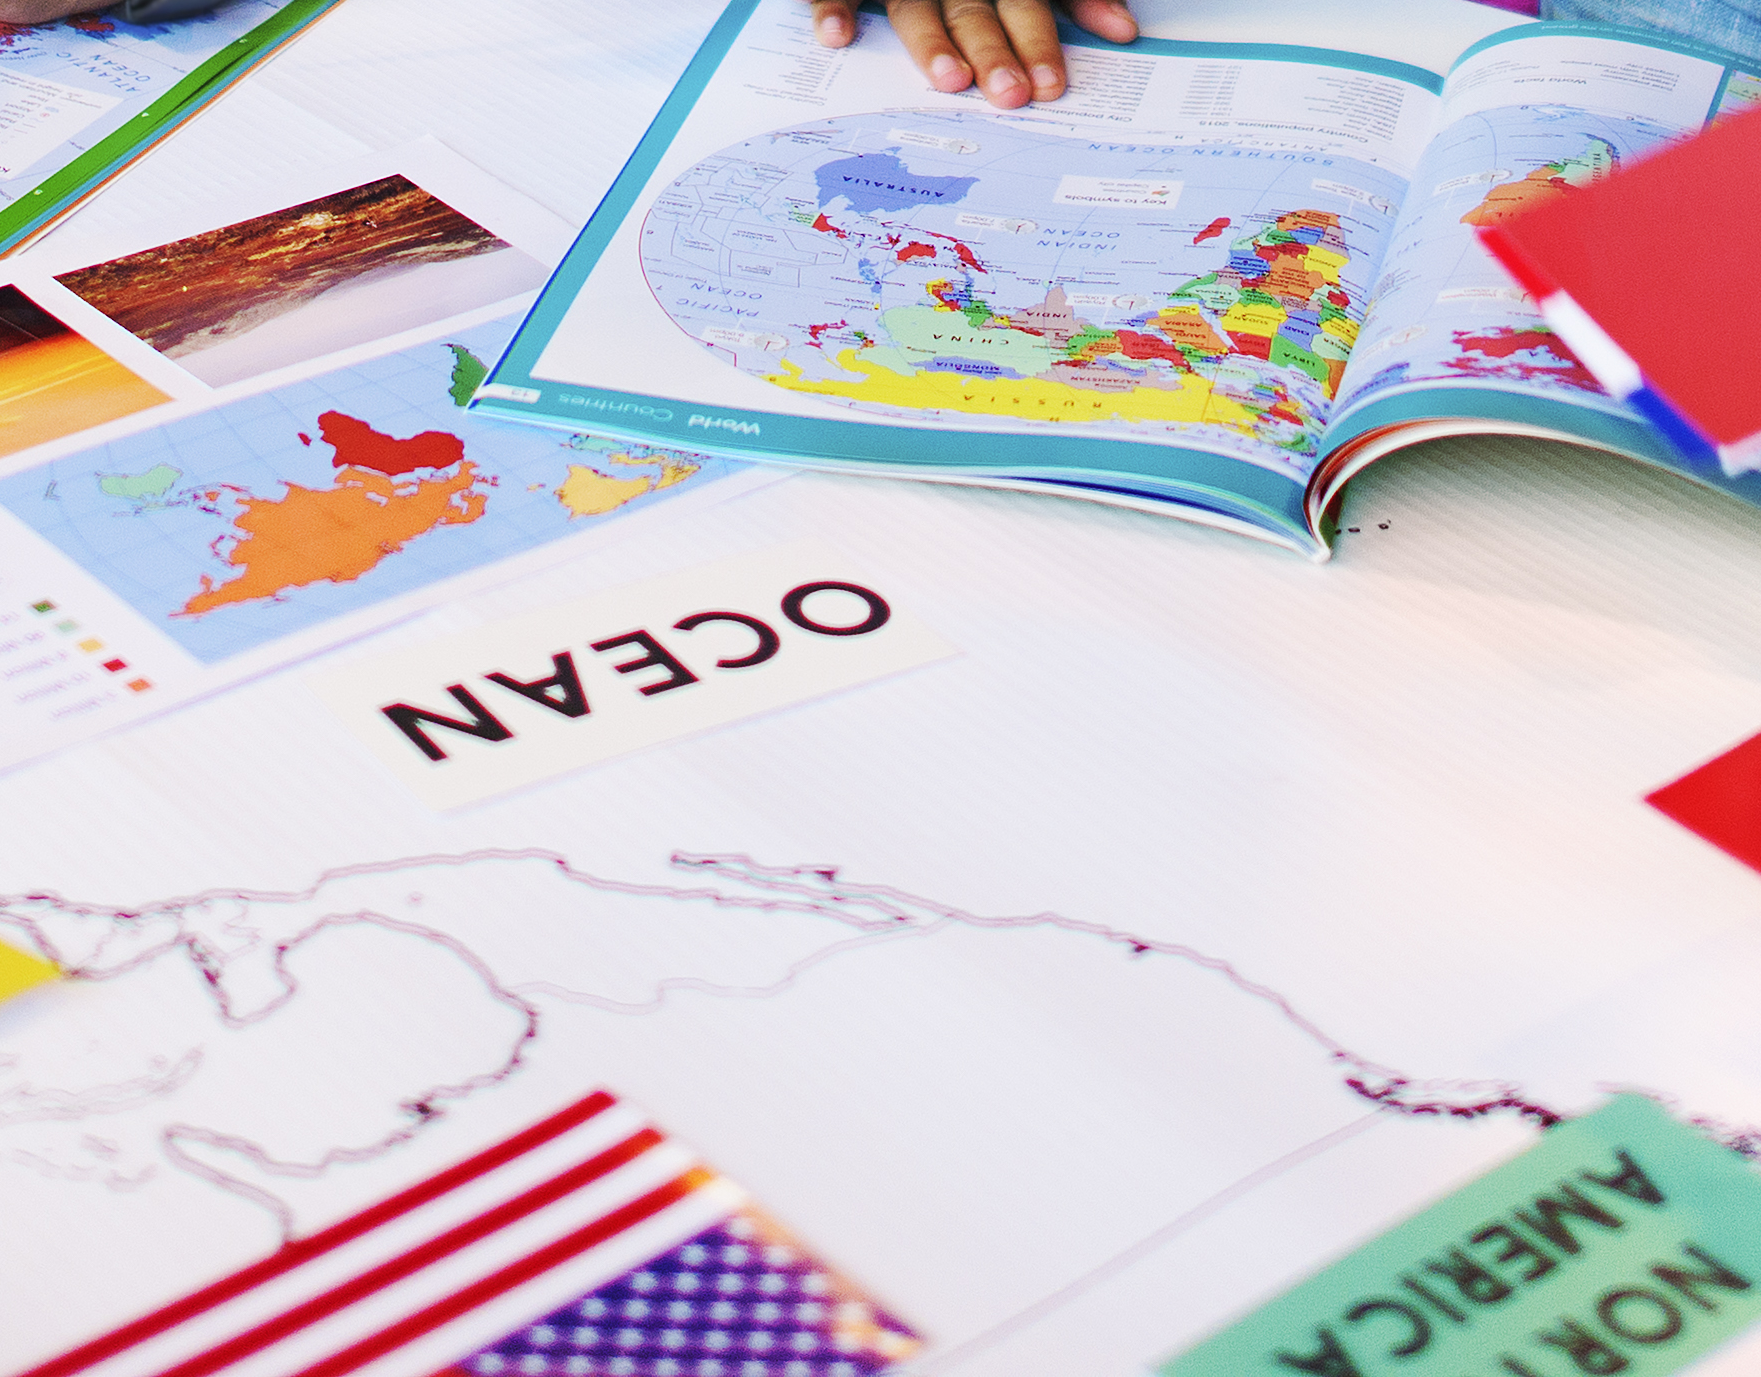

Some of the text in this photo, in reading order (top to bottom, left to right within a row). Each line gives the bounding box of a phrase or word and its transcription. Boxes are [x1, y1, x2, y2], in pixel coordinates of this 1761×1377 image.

[56, 52, 141, 93] ATLANTIC
[89, 54, 151, 83] OCEAN
[1548, 77, 1588, 86] World
[1316, 128, 1369, 144] Country
[1088, 143, 1334, 168] SOUTHERN OCEAN
[841, 175, 945, 199] AUSTRALIA
[1064, 193, 1168, 206] Key to symbols
[1042, 227, 1122, 241] OCEAN
[1036, 239, 1117, 252] INDIAN
[690, 282, 763, 301] OCEAN
[675, 298, 760, 319] PACIFIC
[1025, 310, 1067, 320] INDIA
[932, 333, 1009, 347] CHINA
[936, 361, 1001, 371] MONGOLIA
[1282, 351, 1316, 368] LIBYA
[1070, 375, 1140, 387] KAZAKHSTAN
[559, 393, 674, 423] Countries
[963, 394, 1102, 410] RUSSIA
[687, 413, 761, 437] World
[380, 581, 891, 762] OCEAN
[1271, 1147, 1669, 1377] AMERICA
